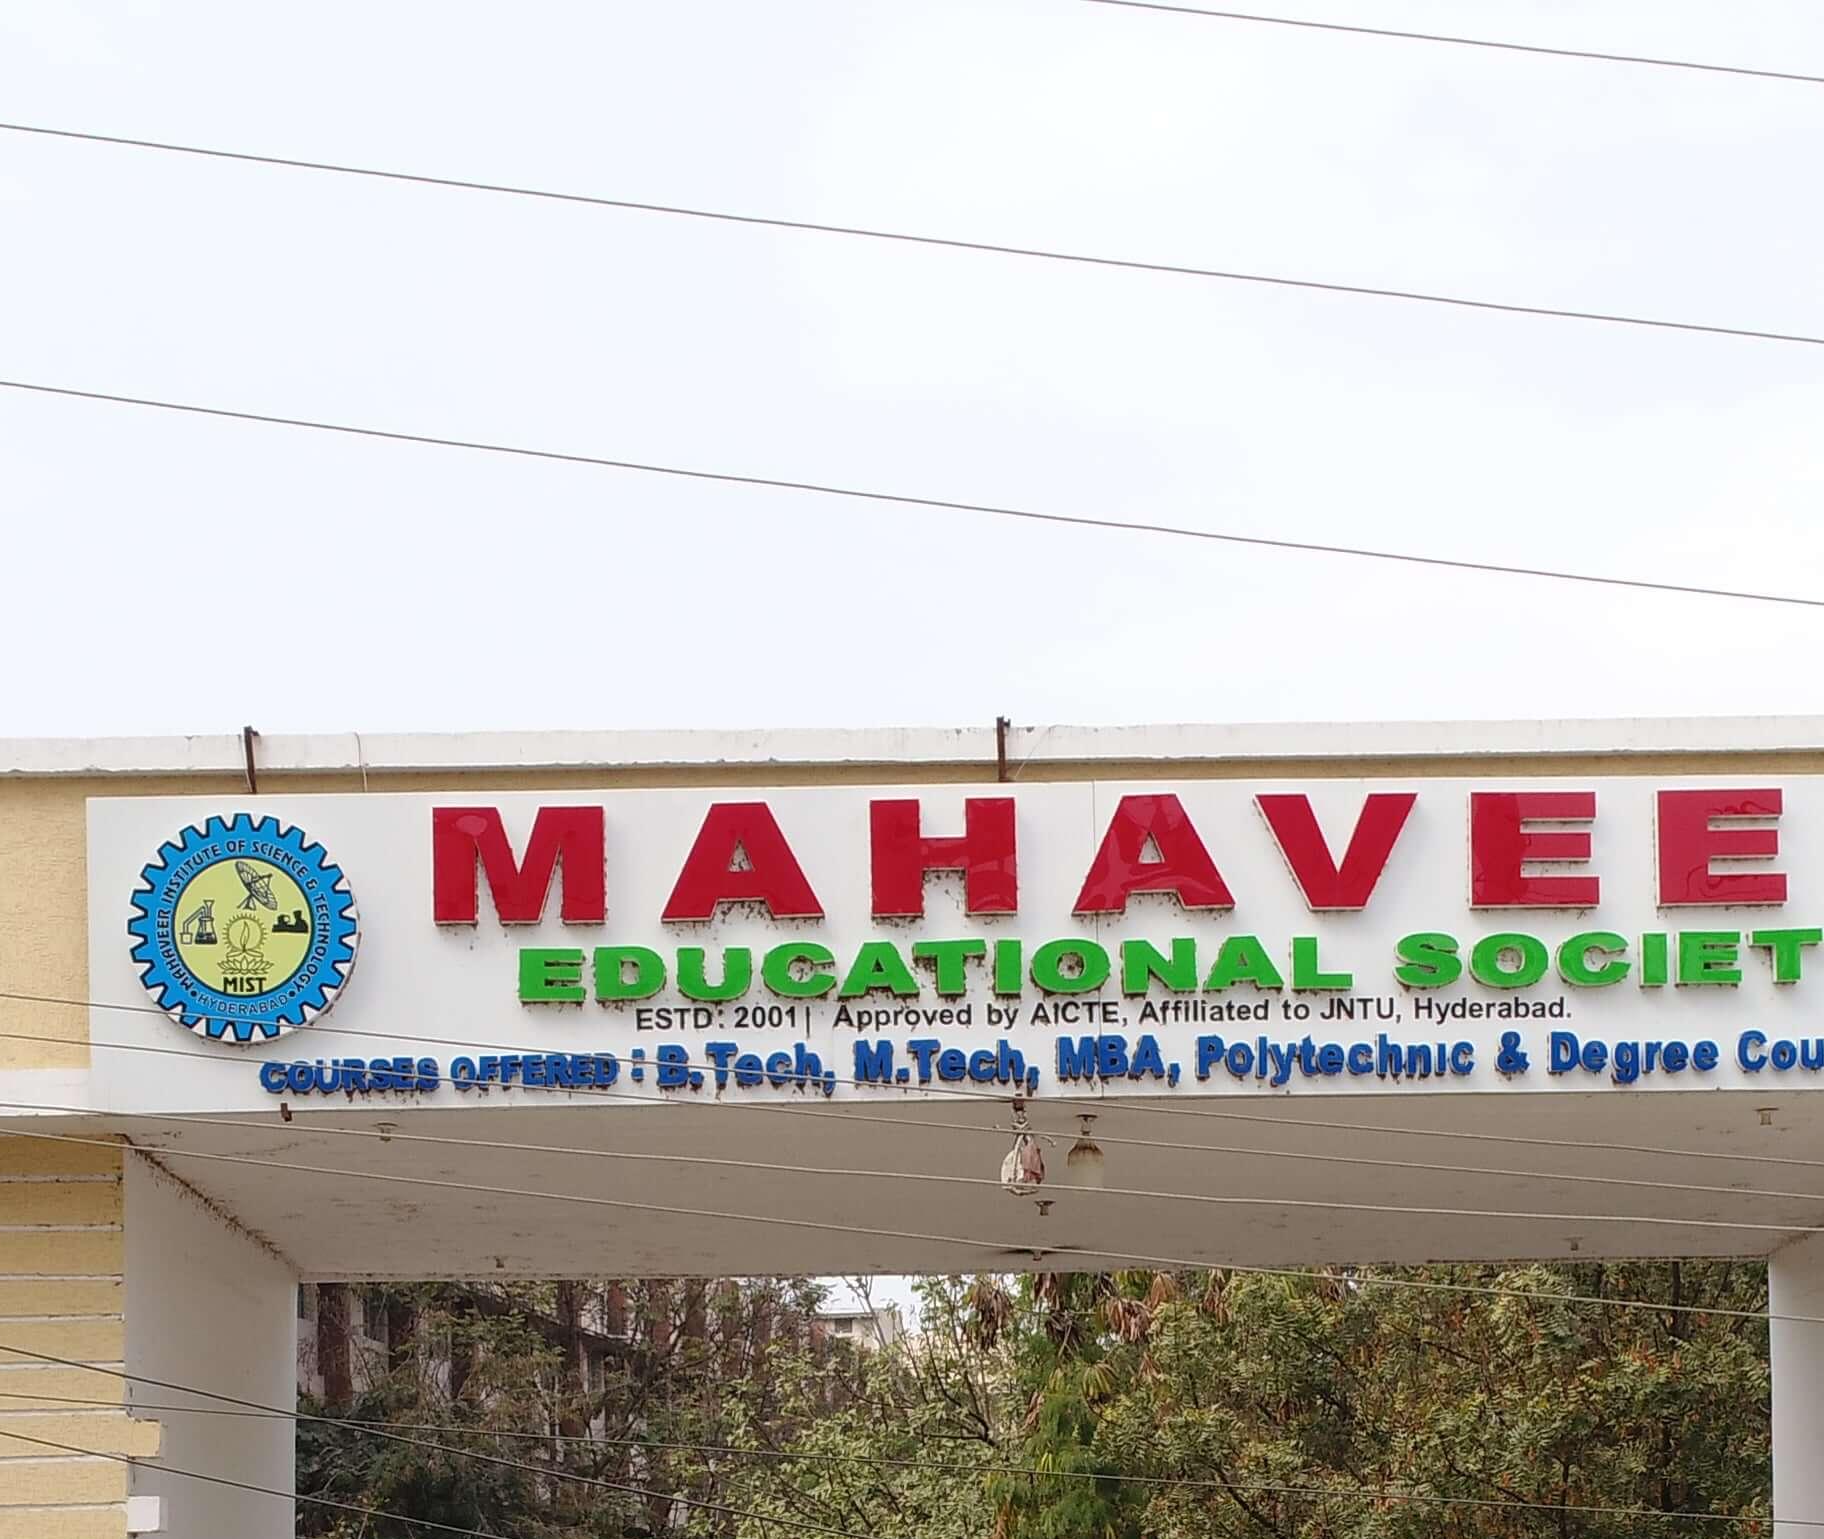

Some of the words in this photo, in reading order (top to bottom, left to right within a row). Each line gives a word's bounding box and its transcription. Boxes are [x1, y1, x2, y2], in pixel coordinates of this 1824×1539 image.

[225, 839, 246, 854] OF
[251, 840, 309, 879] SCIENCE
[162, 843, 222, 905] INSTITUTE
[305, 878, 319, 891] &
[155, 906, 194, 996] MAHAVEER
[292, 893, 332, 993] TECHNOLOGY
[223, 976, 267, 993] MIST
[518, 936, 1353, 1005] EDUCATIONAL
[197, 993, 289, 1016] HYDERABAD
[636, 1006, 726, 1031] ESTD:
[832, 1002, 972, 1033] Approved
[986, 1001, 1019, 1030] by
[1029, 998, 1130, 1027] AICTE,
[1138, 996, 1271, 1025] Affiliated
[1281, 999, 1311, 1021] to
[1318, 996, 1402, 1023] JNTU,
[1414, 994, 1573, 1024] Hyderabad.
[258, 1057, 440, 1095] COURSES
[450, 1052, 621, 1090] OFFERED
[656, 1041, 837, 1096] B.Tech,
[853, 1038, 1041, 1091] M.Tech,
[1055, 1034, 1182, 1086] MBA,
[1194, 1033, 1475, 1087] Polytechnic
[1494, 1031, 1530, 1075] &
[1547, 1030, 1721, 1086] Degree
